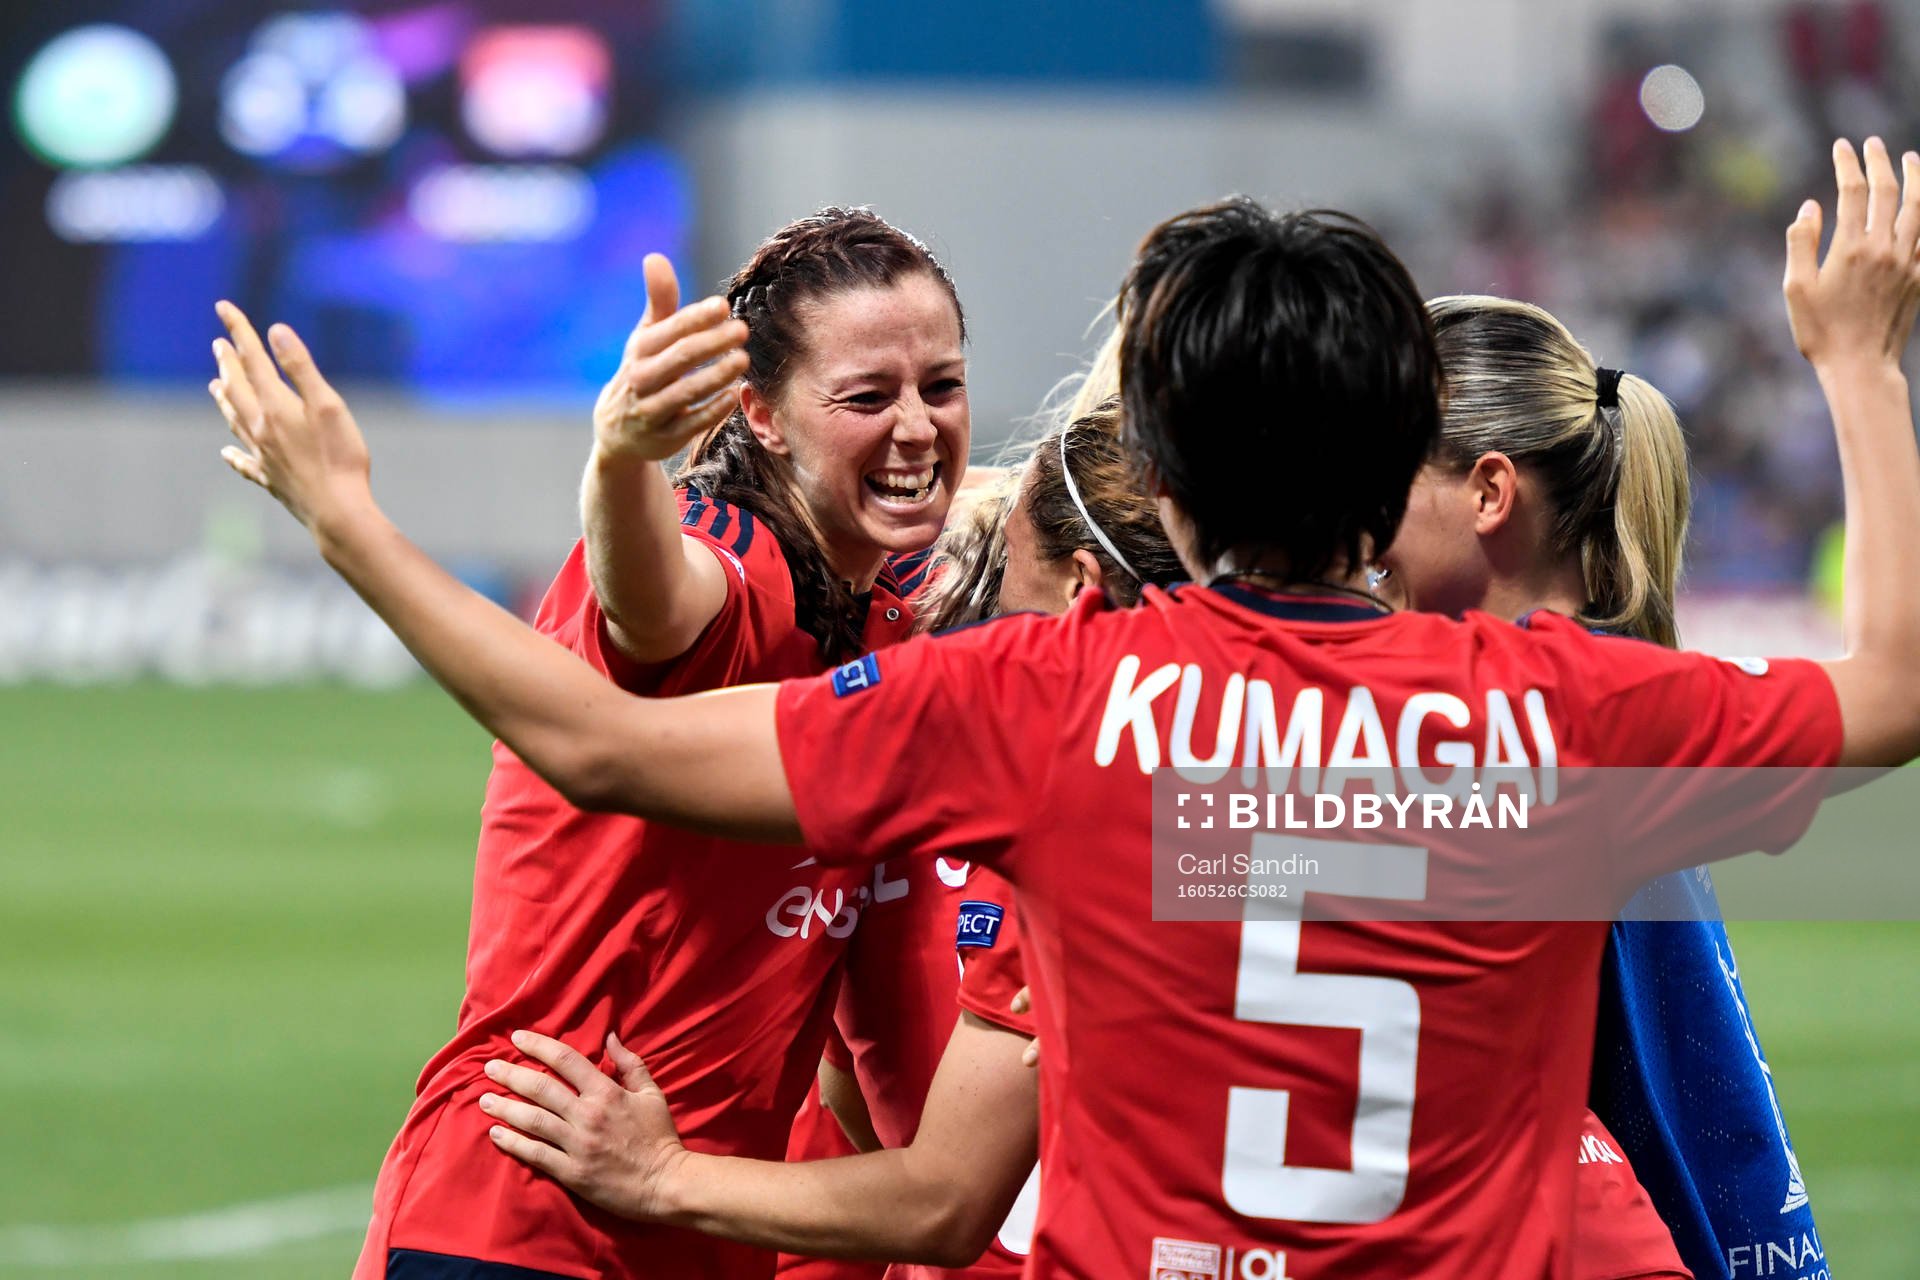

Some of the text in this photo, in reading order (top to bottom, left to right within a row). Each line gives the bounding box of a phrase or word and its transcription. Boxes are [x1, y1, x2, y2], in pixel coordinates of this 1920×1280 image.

[1094, 654, 1559, 807] KUMAGAI
[1222, 831, 1429, 1224] 5
[1728, 1227, 1824, 1279] FINAL
